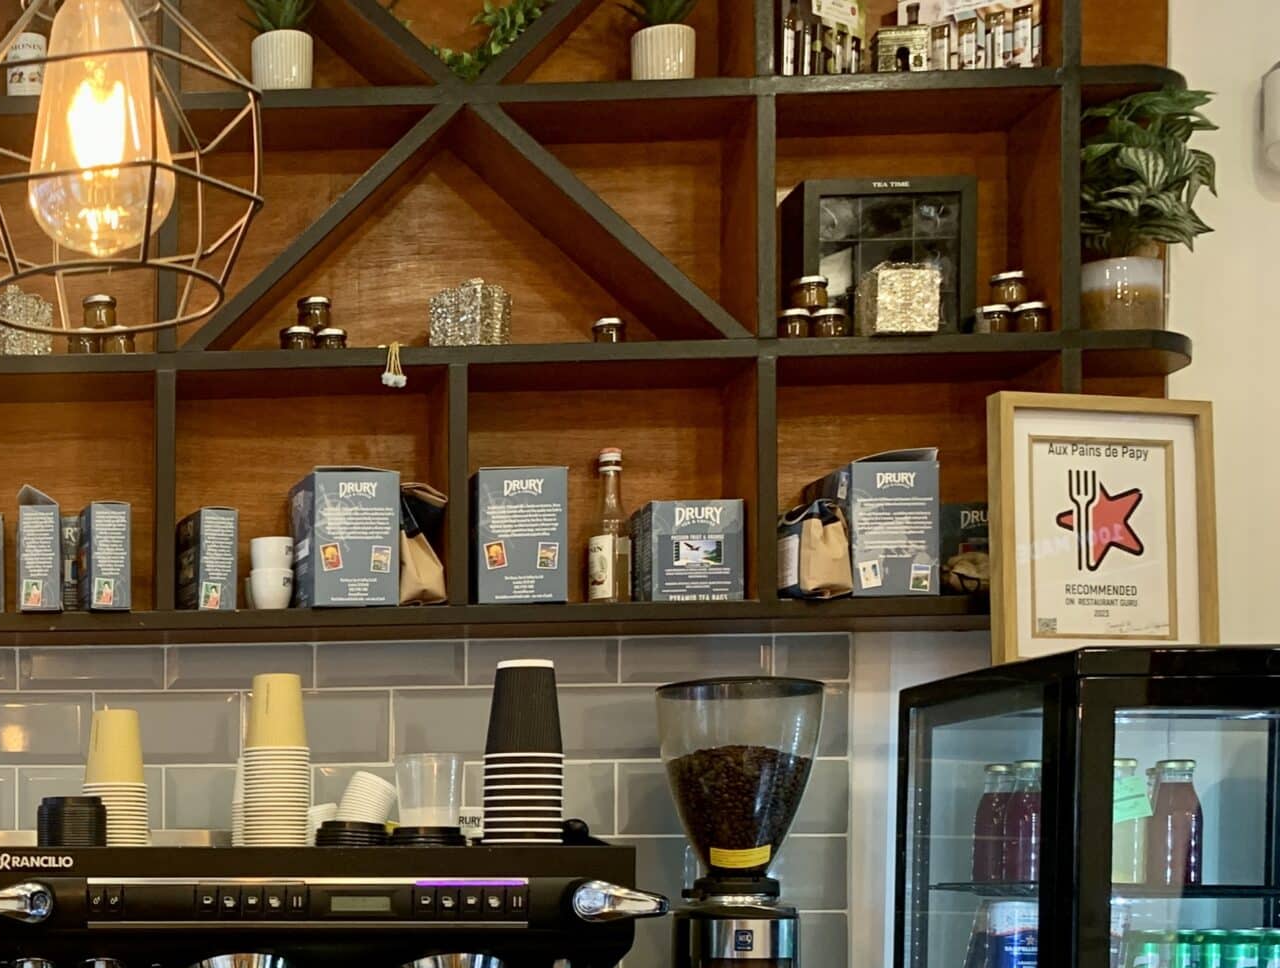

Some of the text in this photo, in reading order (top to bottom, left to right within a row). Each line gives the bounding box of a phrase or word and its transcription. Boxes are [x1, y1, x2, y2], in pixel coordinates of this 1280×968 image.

[1048, 442, 1149, 461] Aux Pains de Papy
[504, 478, 545, 496] DRURY
[876, 472, 916, 488] DRURY
[339, 481, 378, 498] DRURY
[675, 507, 723, 527] DRURY
[960, 510, 989, 529] DRU
[1065, 584, 1138, 596] RECOMMENDED
[1065, 597, 1138, 607] ON RESTAURANT GURU
[458, 815, 482, 828] RURY
[11, 856, 74, 868] RANCILIO
